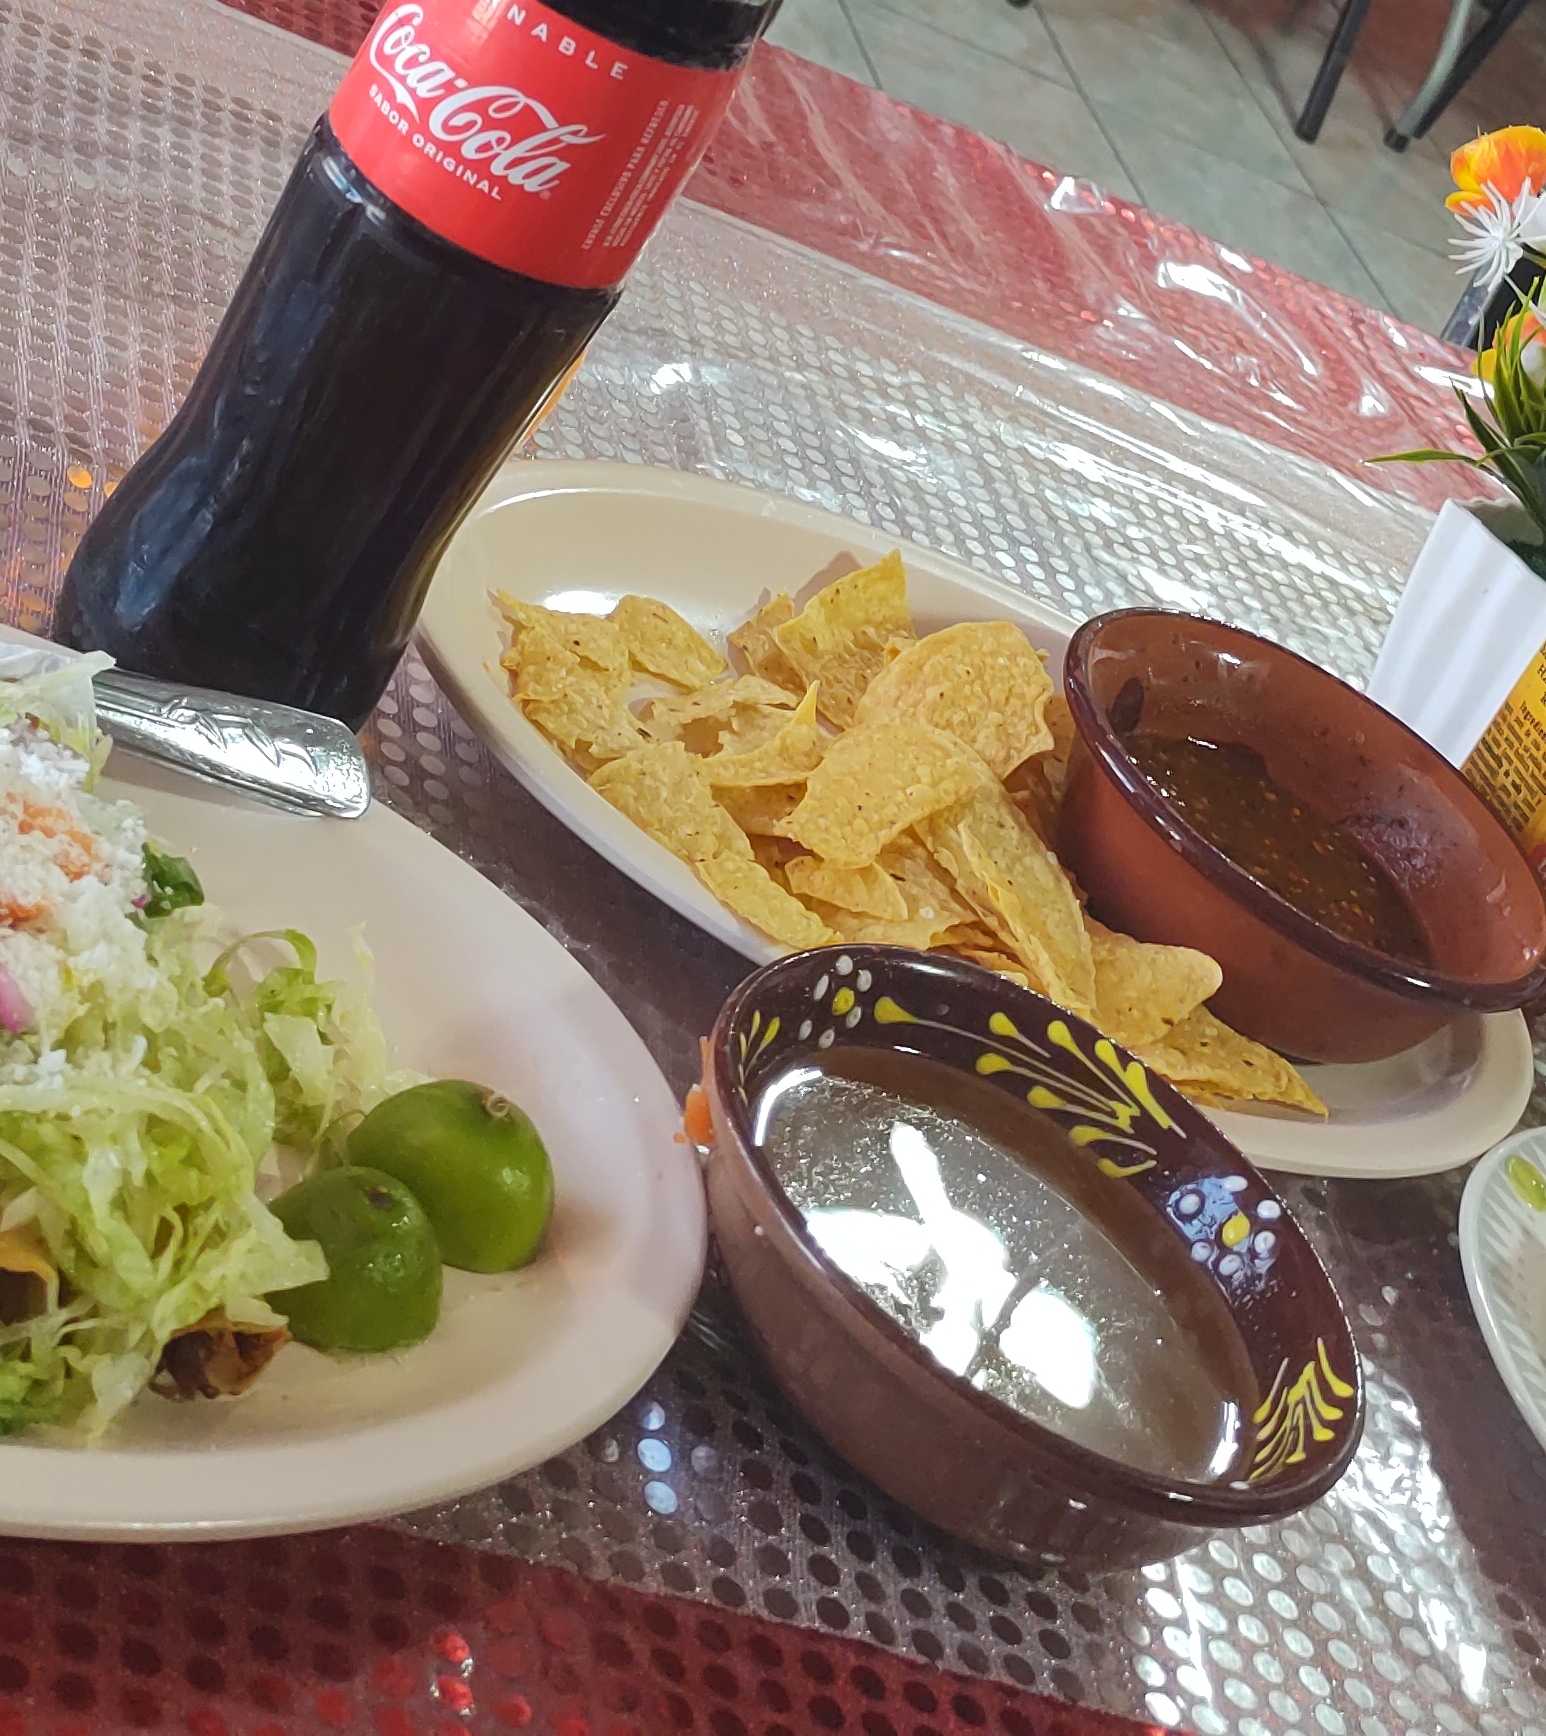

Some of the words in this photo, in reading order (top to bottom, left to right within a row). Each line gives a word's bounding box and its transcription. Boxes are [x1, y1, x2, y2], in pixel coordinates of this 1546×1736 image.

[369, 84, 410, 135] SABOR
[412, 133, 502, 201] ORIGINAL
[370, 3, 606, 193] Coca-Cola
